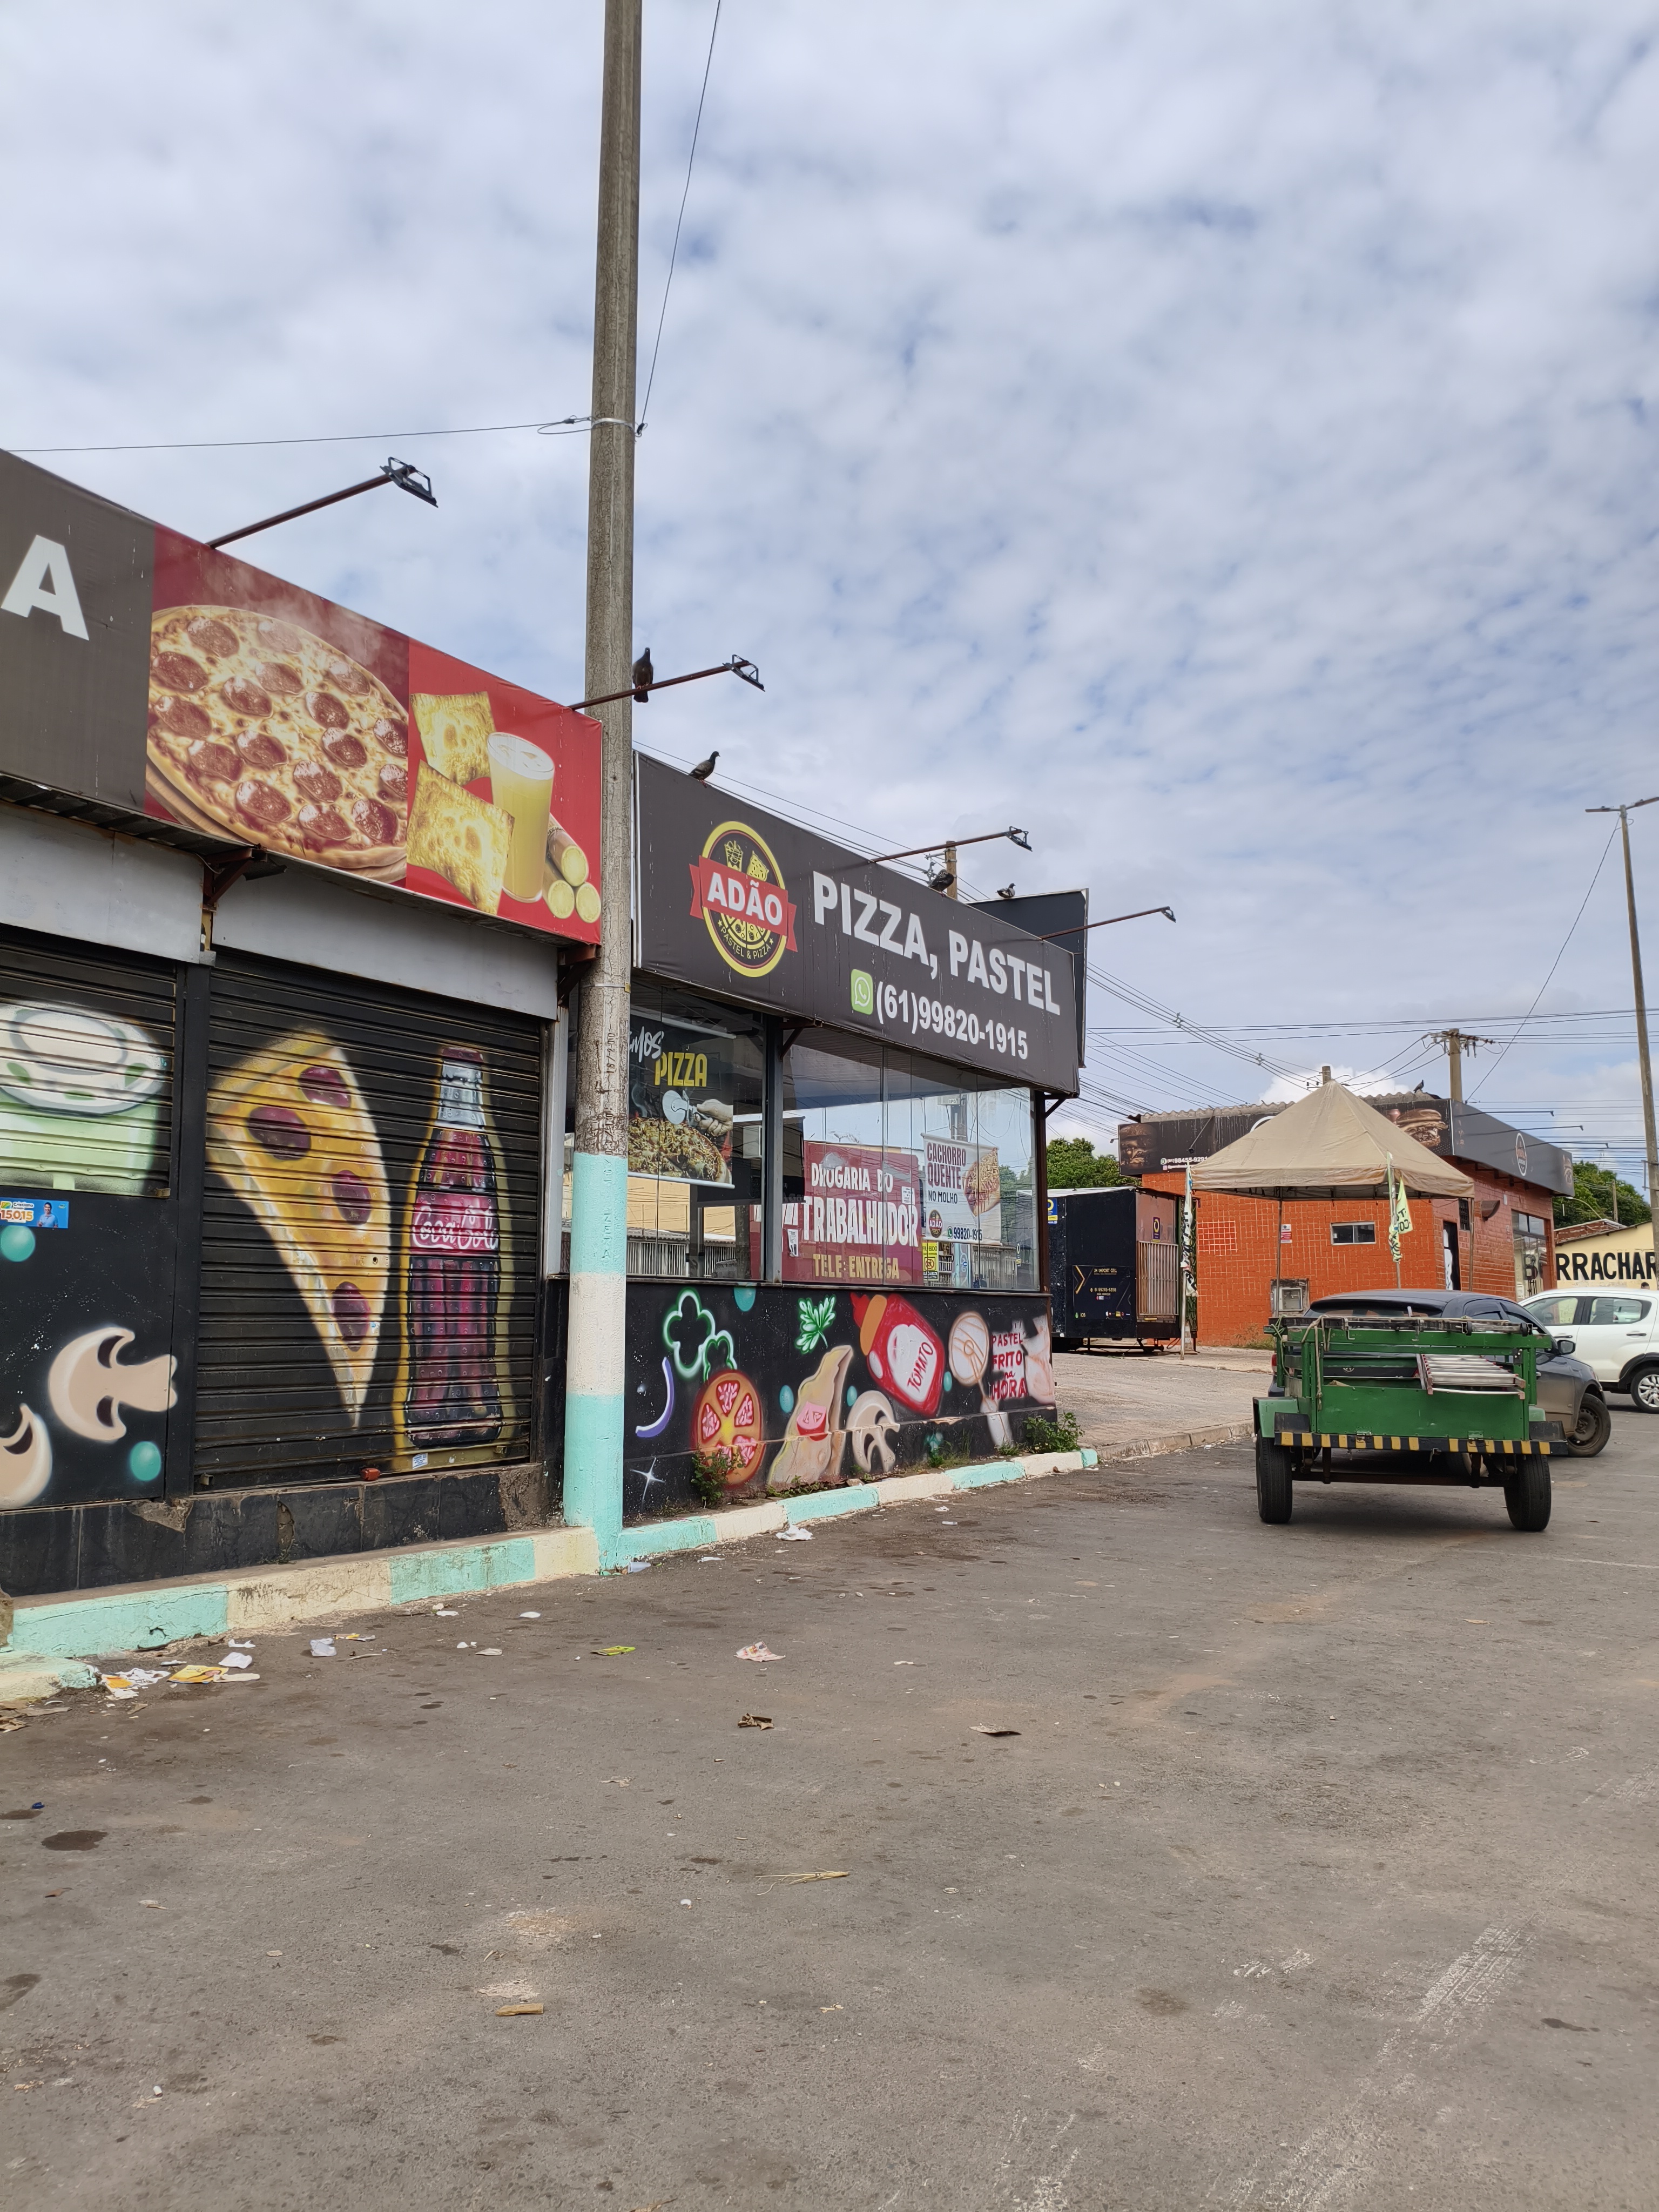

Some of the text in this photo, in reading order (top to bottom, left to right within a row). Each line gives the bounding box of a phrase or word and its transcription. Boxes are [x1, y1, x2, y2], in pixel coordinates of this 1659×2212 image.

[1, 535, 89, 640] A
[707, 872, 783, 926] ADÃO
[720, 926, 771, 960] PASTEL & PIZZA
[813, 871, 1061, 1015] PIZZA, PASTEL
[876, 981, 1028, 1060] (61)99820-1915
[655, 1052, 707, 1087] PIZZA
[927, 1142, 967, 1166] CACHORRO
[927, 1162, 962, 1190] QUENTE
[928, 1190, 958, 1204] NO MOLHO
[1, 1210, 33, 1220] 15015
[929, 1219, 943, 1228] ADÃO
[992, 1332, 1024, 1348] PASTEL
[992, 1351, 1022, 1370] FRITO
[991, 1378, 1027, 1401] HORA
